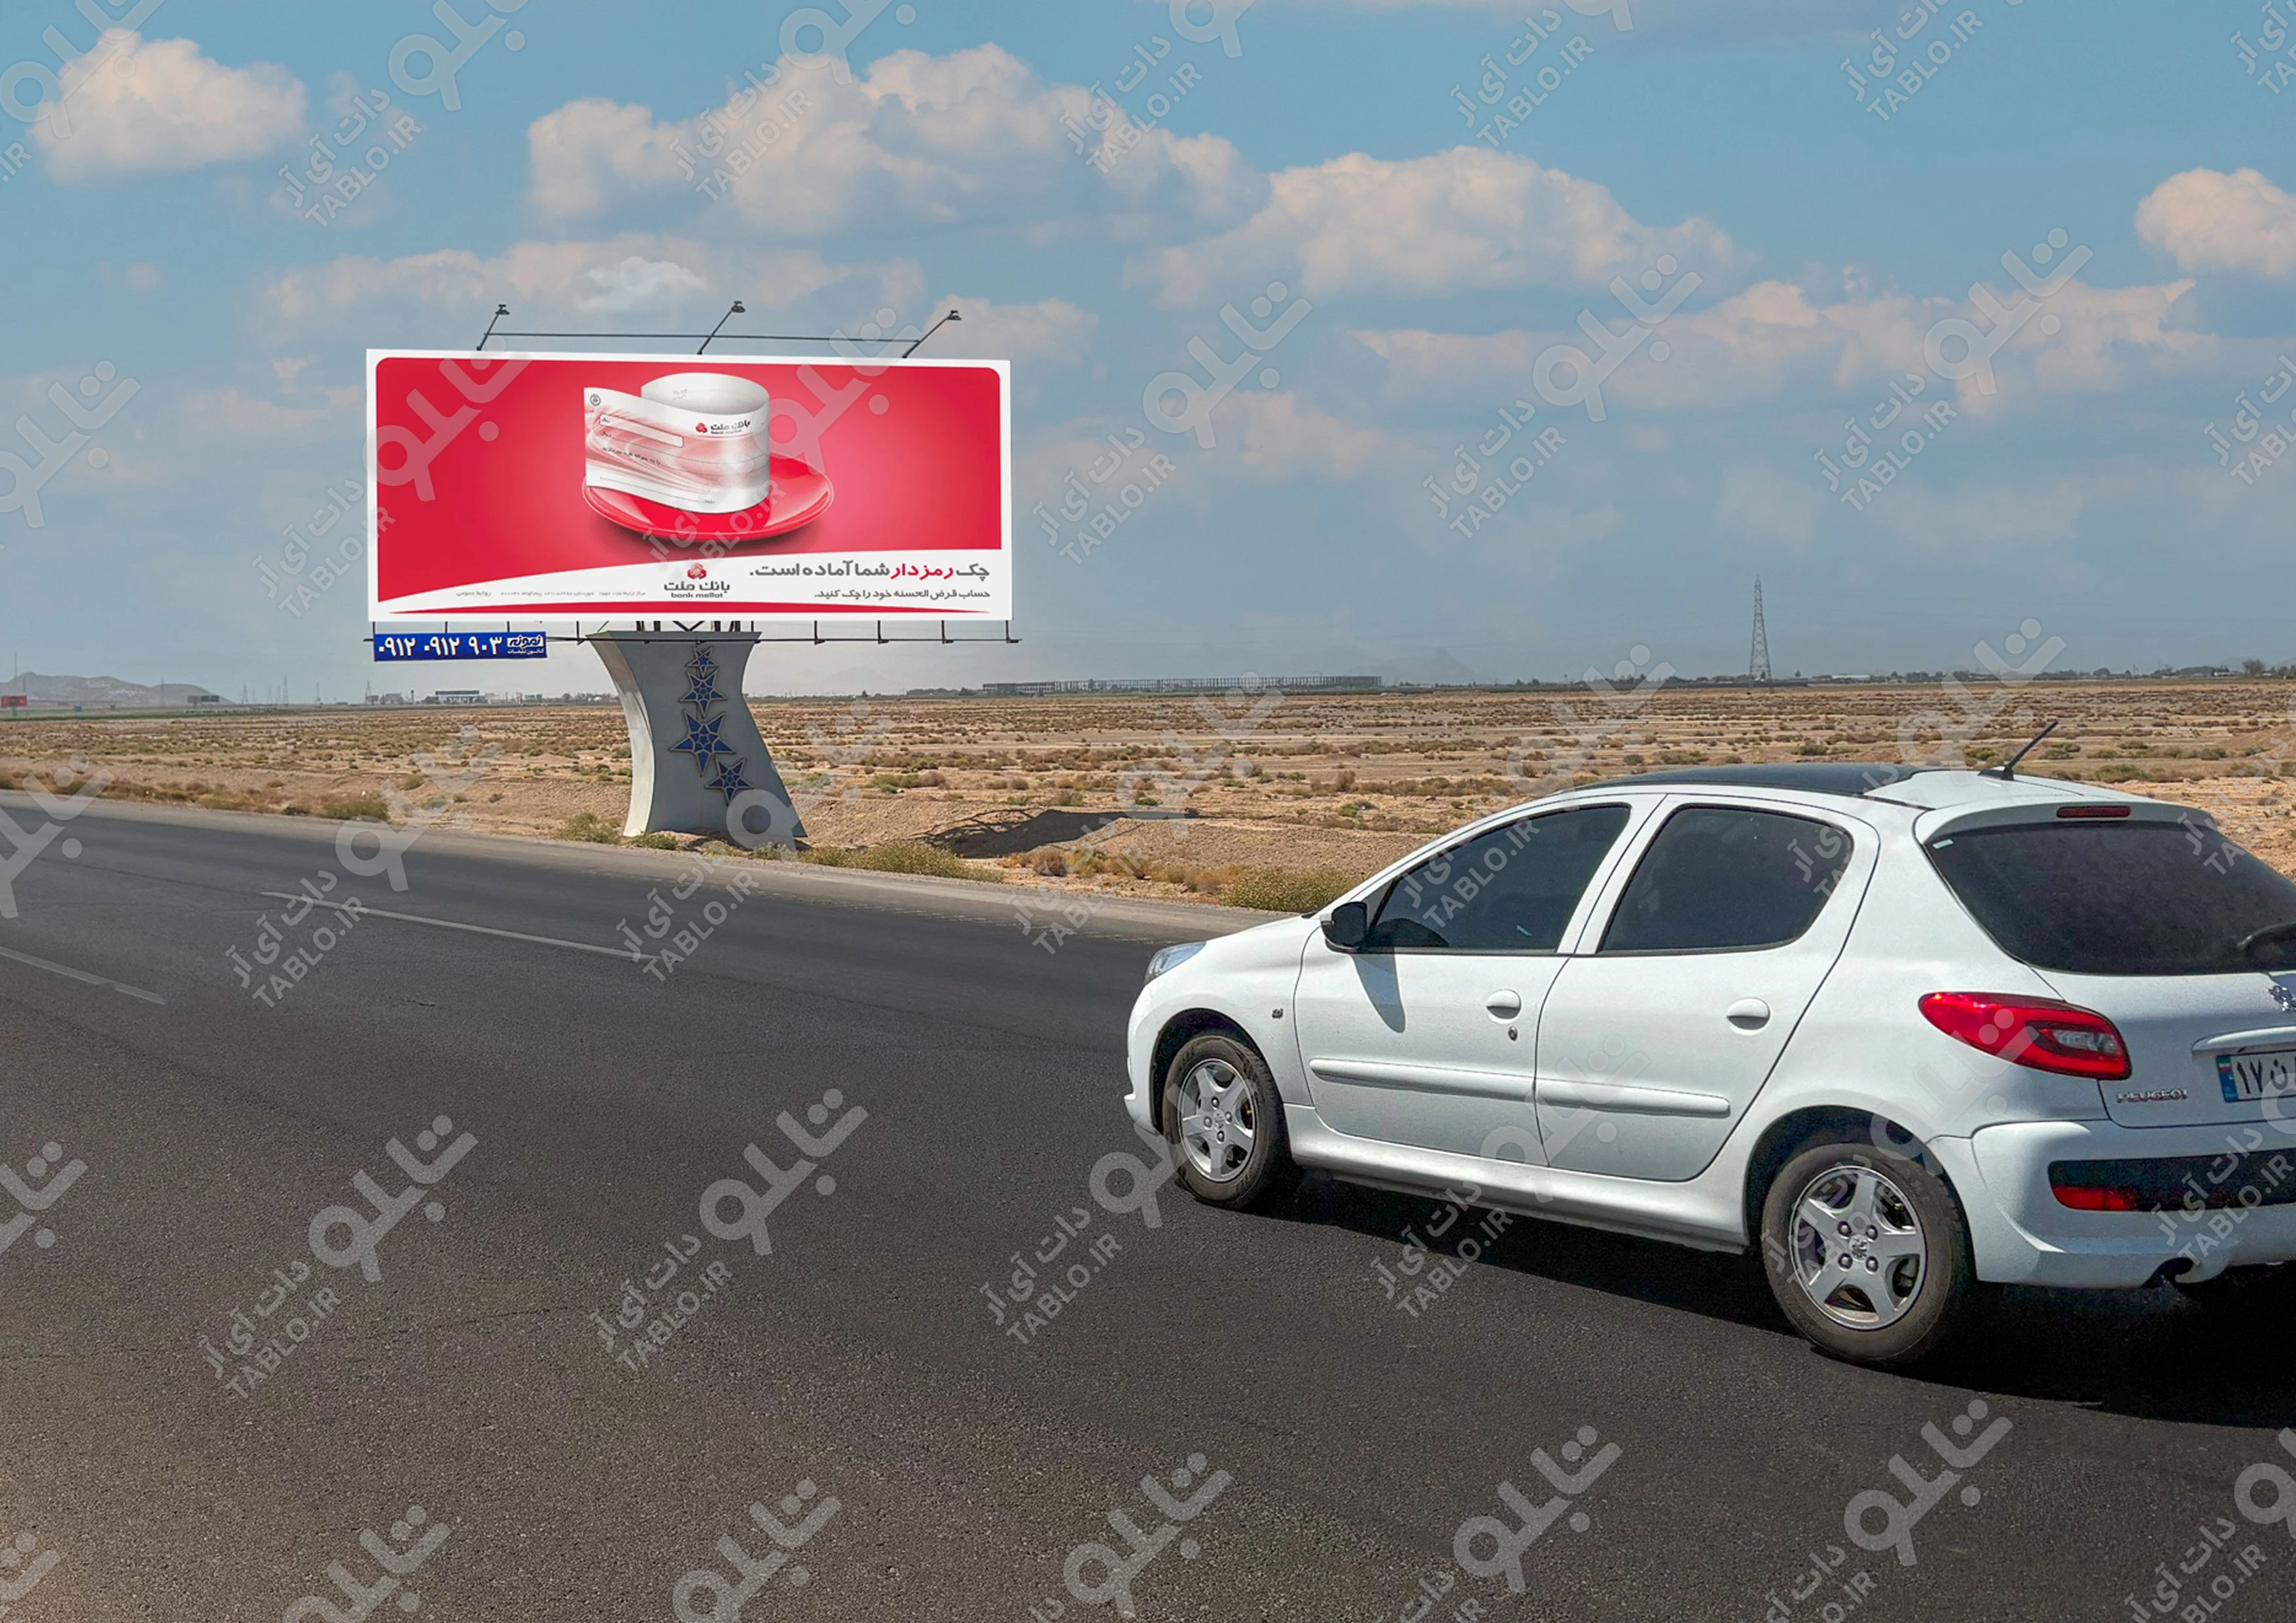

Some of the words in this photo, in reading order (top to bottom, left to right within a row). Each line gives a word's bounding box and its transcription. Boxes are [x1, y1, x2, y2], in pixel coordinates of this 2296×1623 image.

[749, 563, 799, 576] است.
[802, 560, 852, 576] آماده
[854, 562, 890, 576] شما
[890, 562, 954, 580] رمزدار
[956, 563, 990, 581] چک
[664, 580, 695, 590] ملت
[841, 589, 861, 599] چک
[863, 590, 871, 599] را
[872, 590, 891, 600] خود
[893, 589, 929, 598] الحسنه
[930, 589, 958, 600] قرض
[958, 589, 990, 599] حساب
[378, 637, 416, 657] ۰۹۱۲
[424, 636, 459, 656] ۰۹۱۲
[468, 636, 503, 656] ۹۰۳
[508, 635, 543, 648] نمونه
[2117, 1088, 2188, 1103] PEUGEOT
